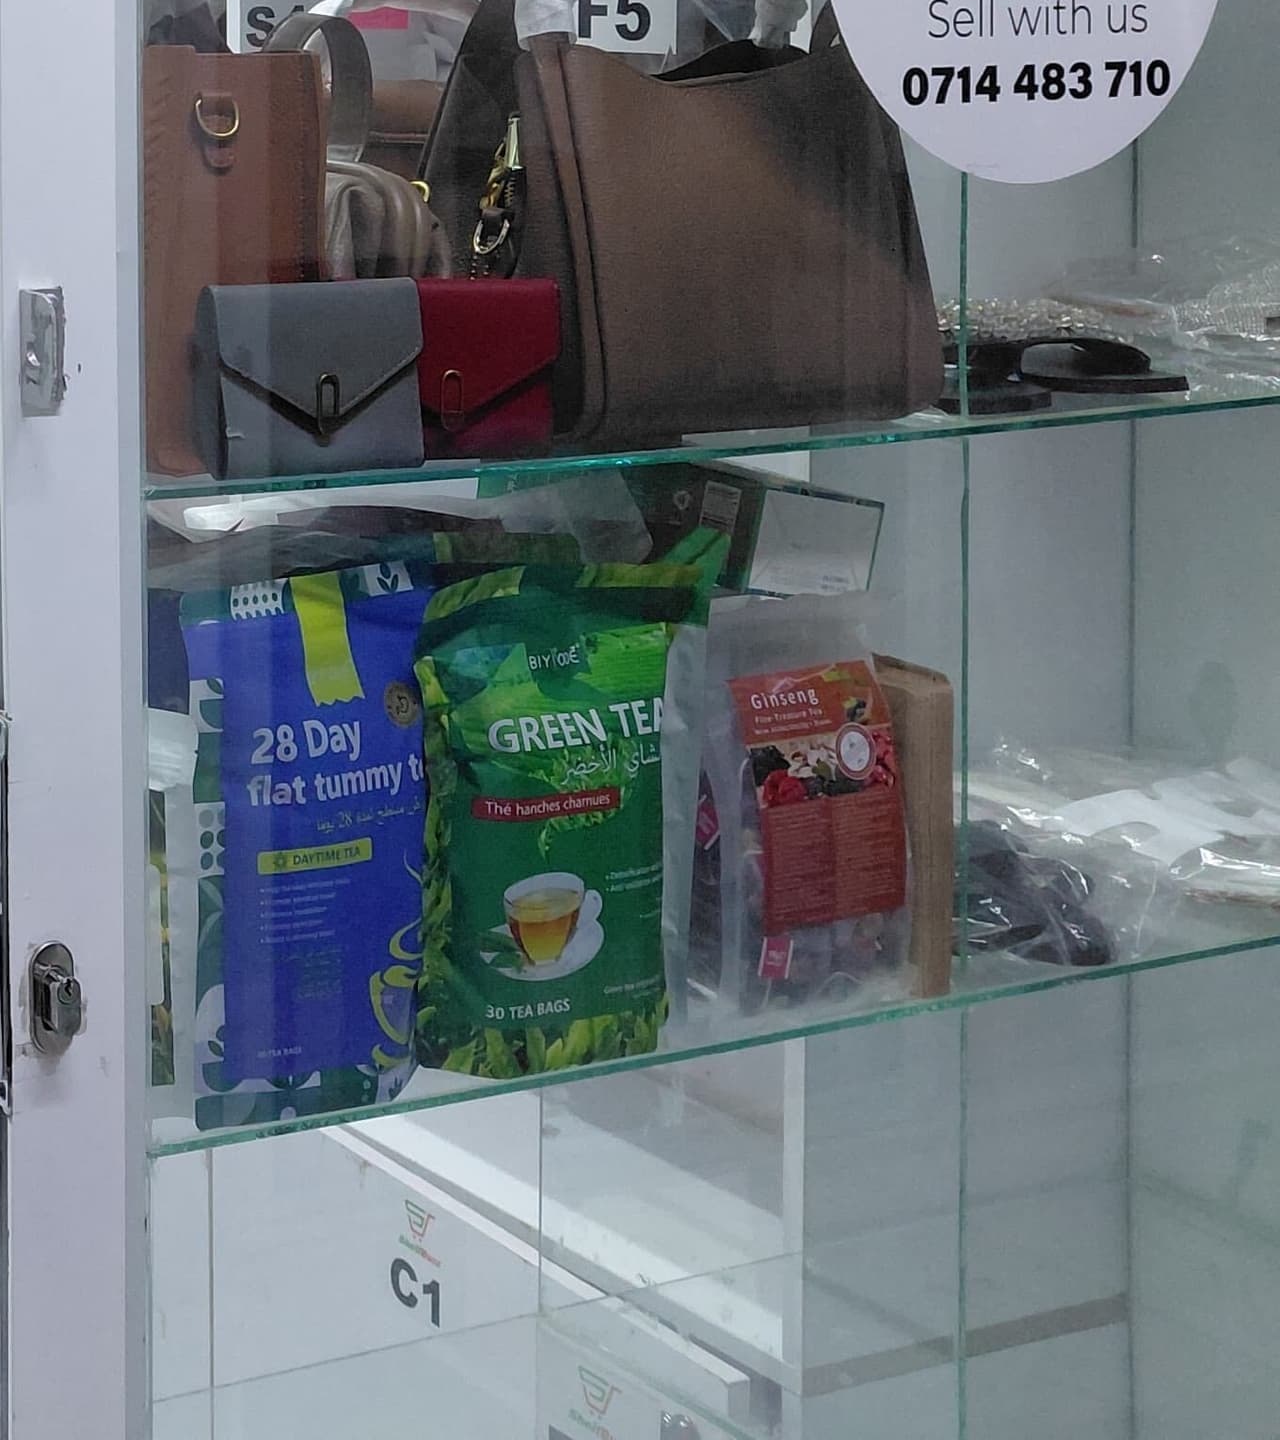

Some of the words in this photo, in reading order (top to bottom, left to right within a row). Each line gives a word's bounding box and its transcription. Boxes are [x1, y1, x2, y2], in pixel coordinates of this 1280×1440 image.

[1107, 2, 1148, 34] us
[902, 65, 1001, 106] 0714
[1014, 63, 1093, 102] 483
[1104, 59, 1171, 99] 710
[751, 689, 819, 709] Ginseng
[251, 724, 298, 765] 28
[302, 719, 361, 762] Day
[488, 709, 607, 753] GREEN
[609, 697, 665, 738] TEA
[246, 774, 307, 807] flat
[314, 761, 403, 802] tummy
[486, 800, 512, 816] Thé
[516, 800, 561, 816] hanches
[486, 1004, 505, 1020] 30
[509, 1003, 534, 1019] TEA
[537, 998, 571, 1016] BAGS
[390, 1258, 441, 1329] C1
